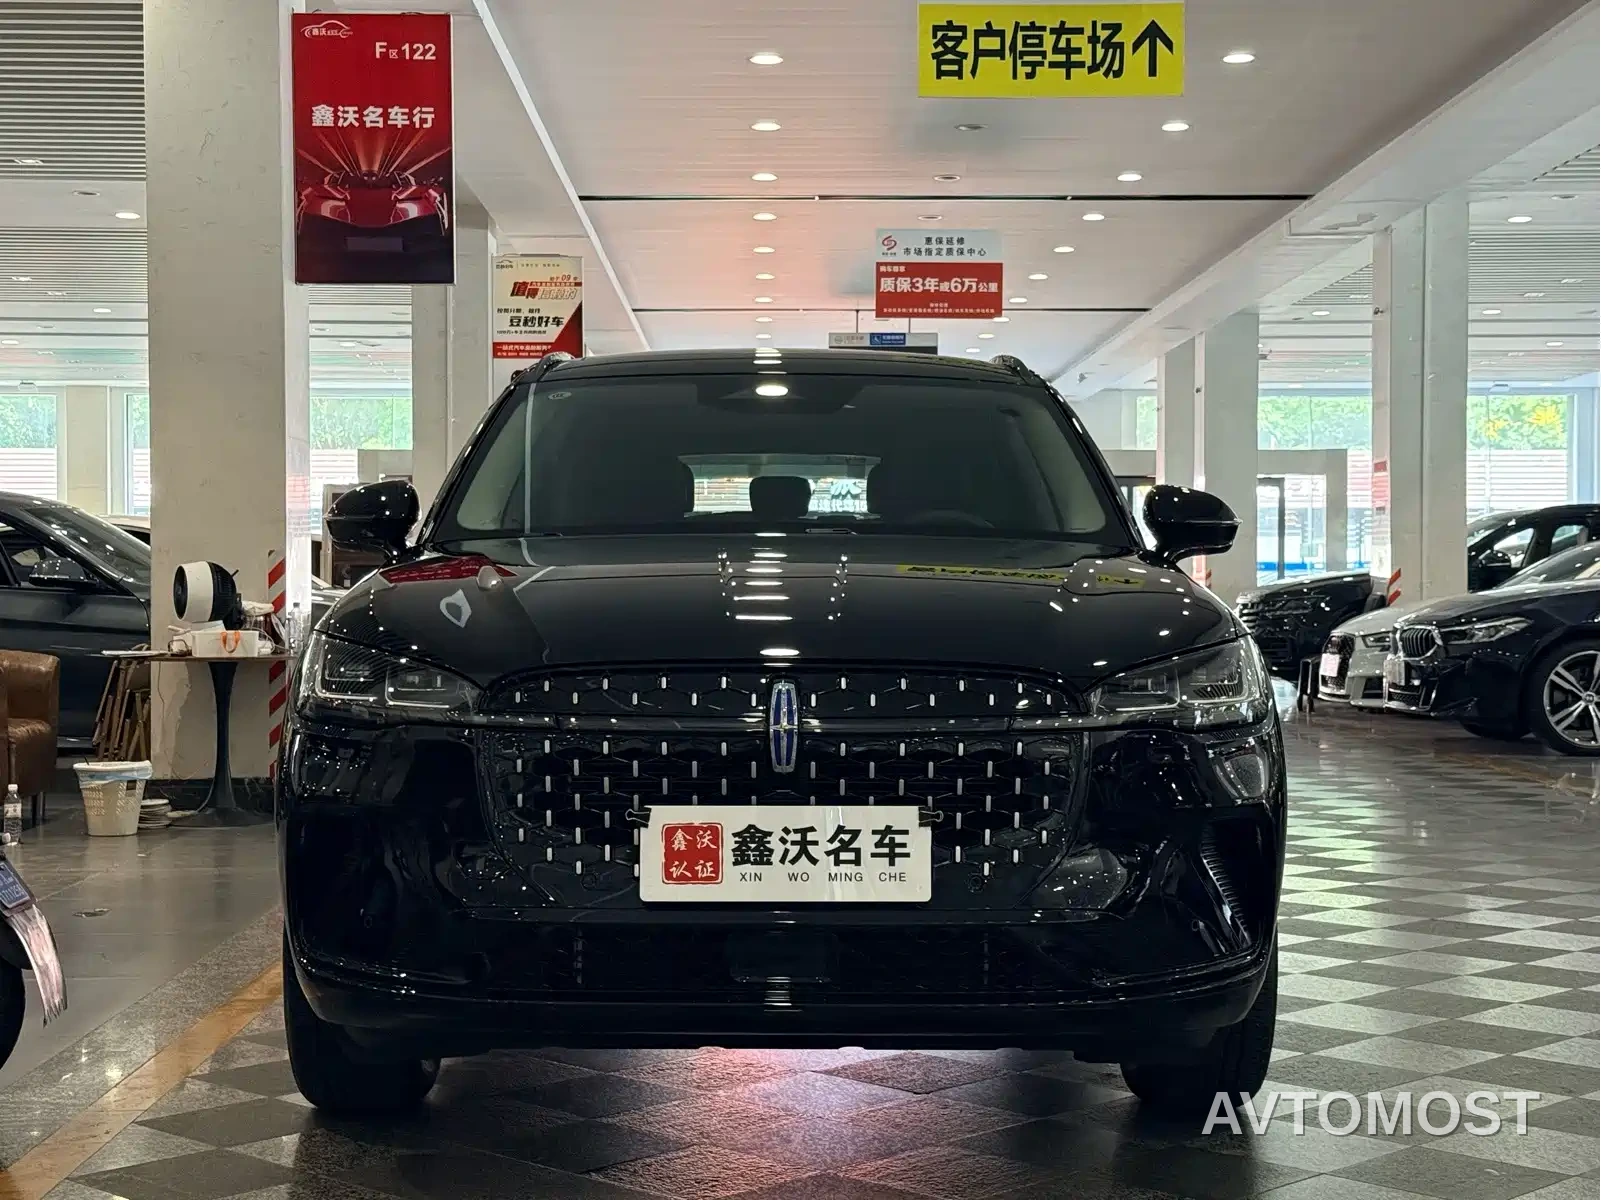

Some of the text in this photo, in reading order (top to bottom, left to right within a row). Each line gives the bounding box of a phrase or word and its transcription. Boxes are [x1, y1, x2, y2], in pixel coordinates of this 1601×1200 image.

[931, 20, 1125, 81] 客户停车场
[311, 104, 436, 129] 鑫沃名车行
[924, 236, 965, 246] 惠保延修
[903, 247, 987, 257] 市场指定质保中心
[879, 277, 999, 293] 质保3年或6万公里
[508, 315, 565, 328] 豆秒好车
[670, 828, 717, 852] 鑫沃
[731, 824, 912, 867] 鑫沃名车
[669, 858, 717, 878] 认证
[739, 871, 907, 882] XIN WO MING CHE
